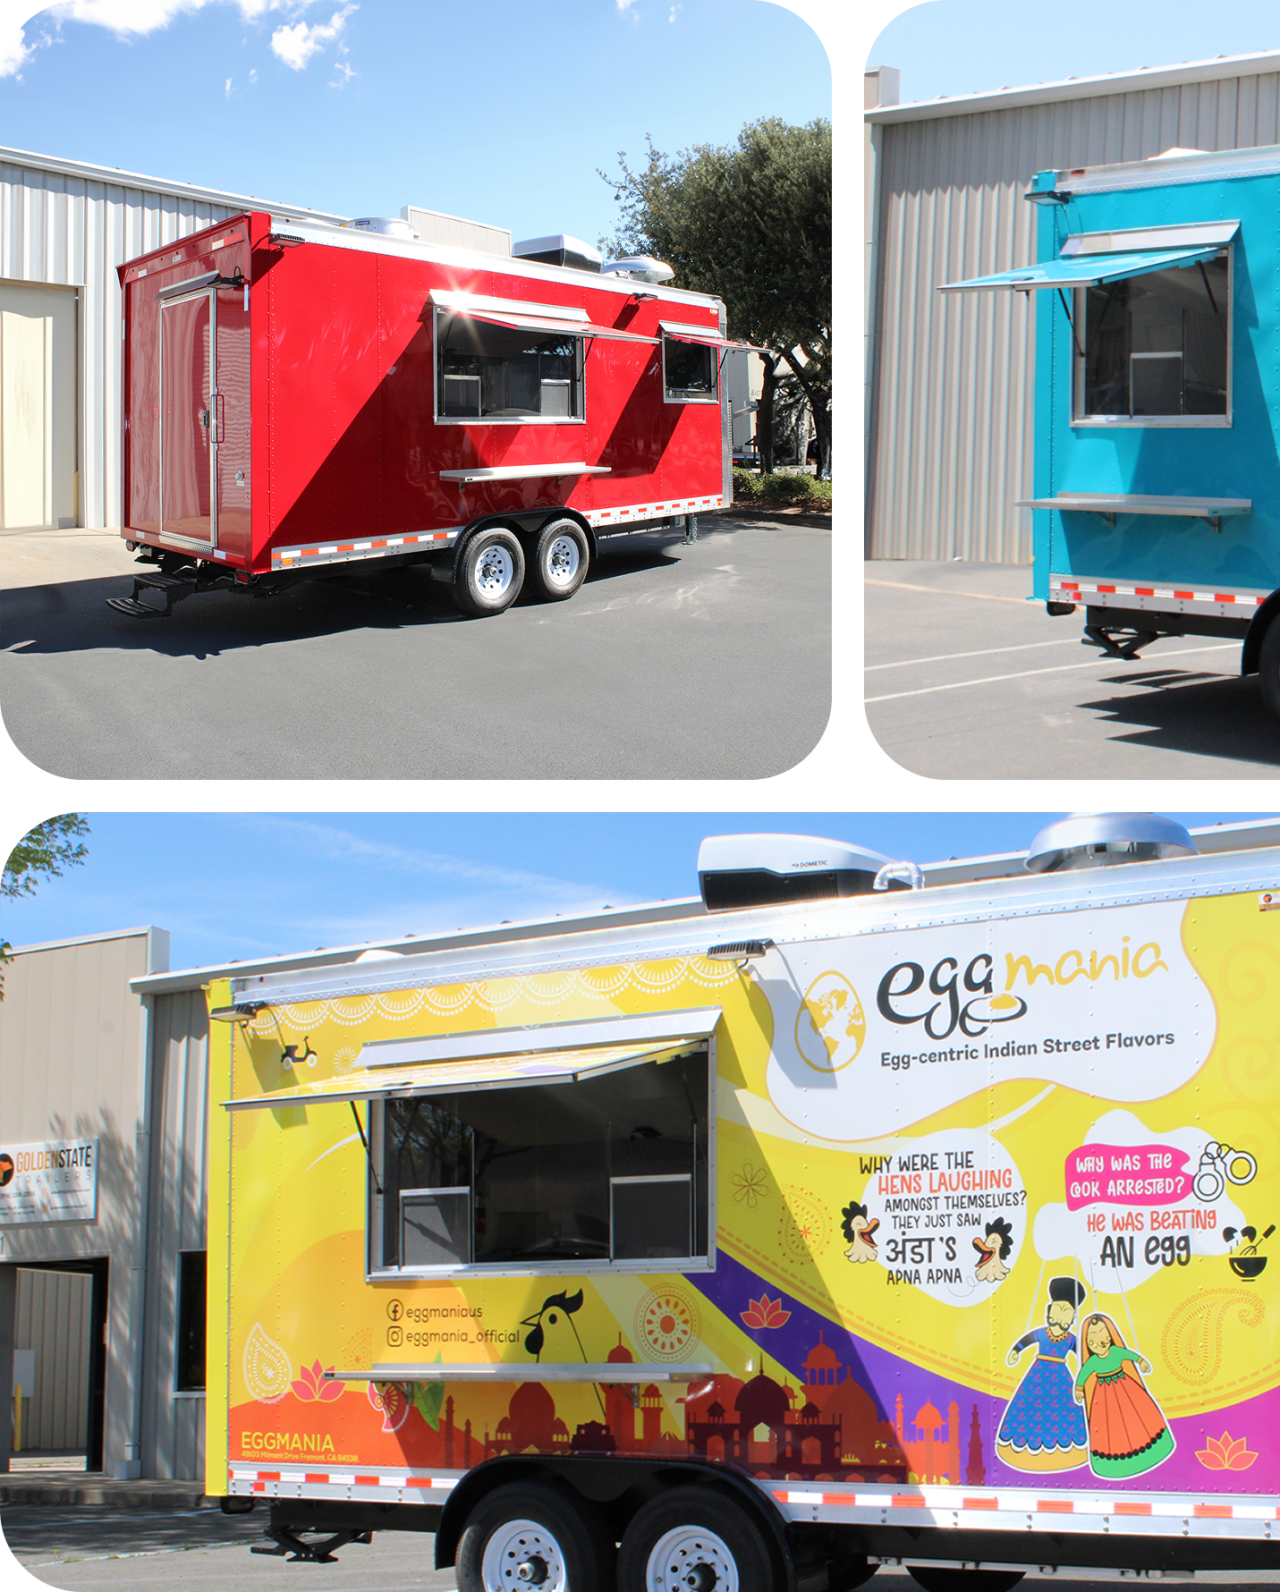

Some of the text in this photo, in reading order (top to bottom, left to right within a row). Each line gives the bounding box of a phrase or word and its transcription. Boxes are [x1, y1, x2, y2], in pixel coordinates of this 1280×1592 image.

[800, 860, 828, 868] DOMETIC
[1005, 935, 1169, 991] mania
[880, 1031, 1175, 1070] Egg-centric Indian Street Flavors
[16, 1145, 92, 1173] GOLDENSTATE
[859, 1151, 974, 1174] WHY WERE THE
[1076, 1155, 1104, 1173] WHY
[1111, 1154, 1141, 1171] WAS
[16, 1169, 92, 1183] TRAILERS
[878, 1168, 1012, 1195] HENS LAUGHING
[884, 1190, 1027, 1212] AMONGST THEMSELVES?
[892, 1212, 981, 1230] THEY JUST SAW
[1111, 1211, 1144, 1232] WAS
[1100, 1235, 1191, 1268] AN egg
[886, 1268, 962, 1285] APNA APNA
[406, 1304, 483, 1323] eggmaniaus
[406, 1329, 520, 1347] eggmania_official
[241, 1431, 335, 1452] EGGMANIA
[284, 1452, 299, 1460] Drive
[300, 1453, 326, 1461] Fremont,
